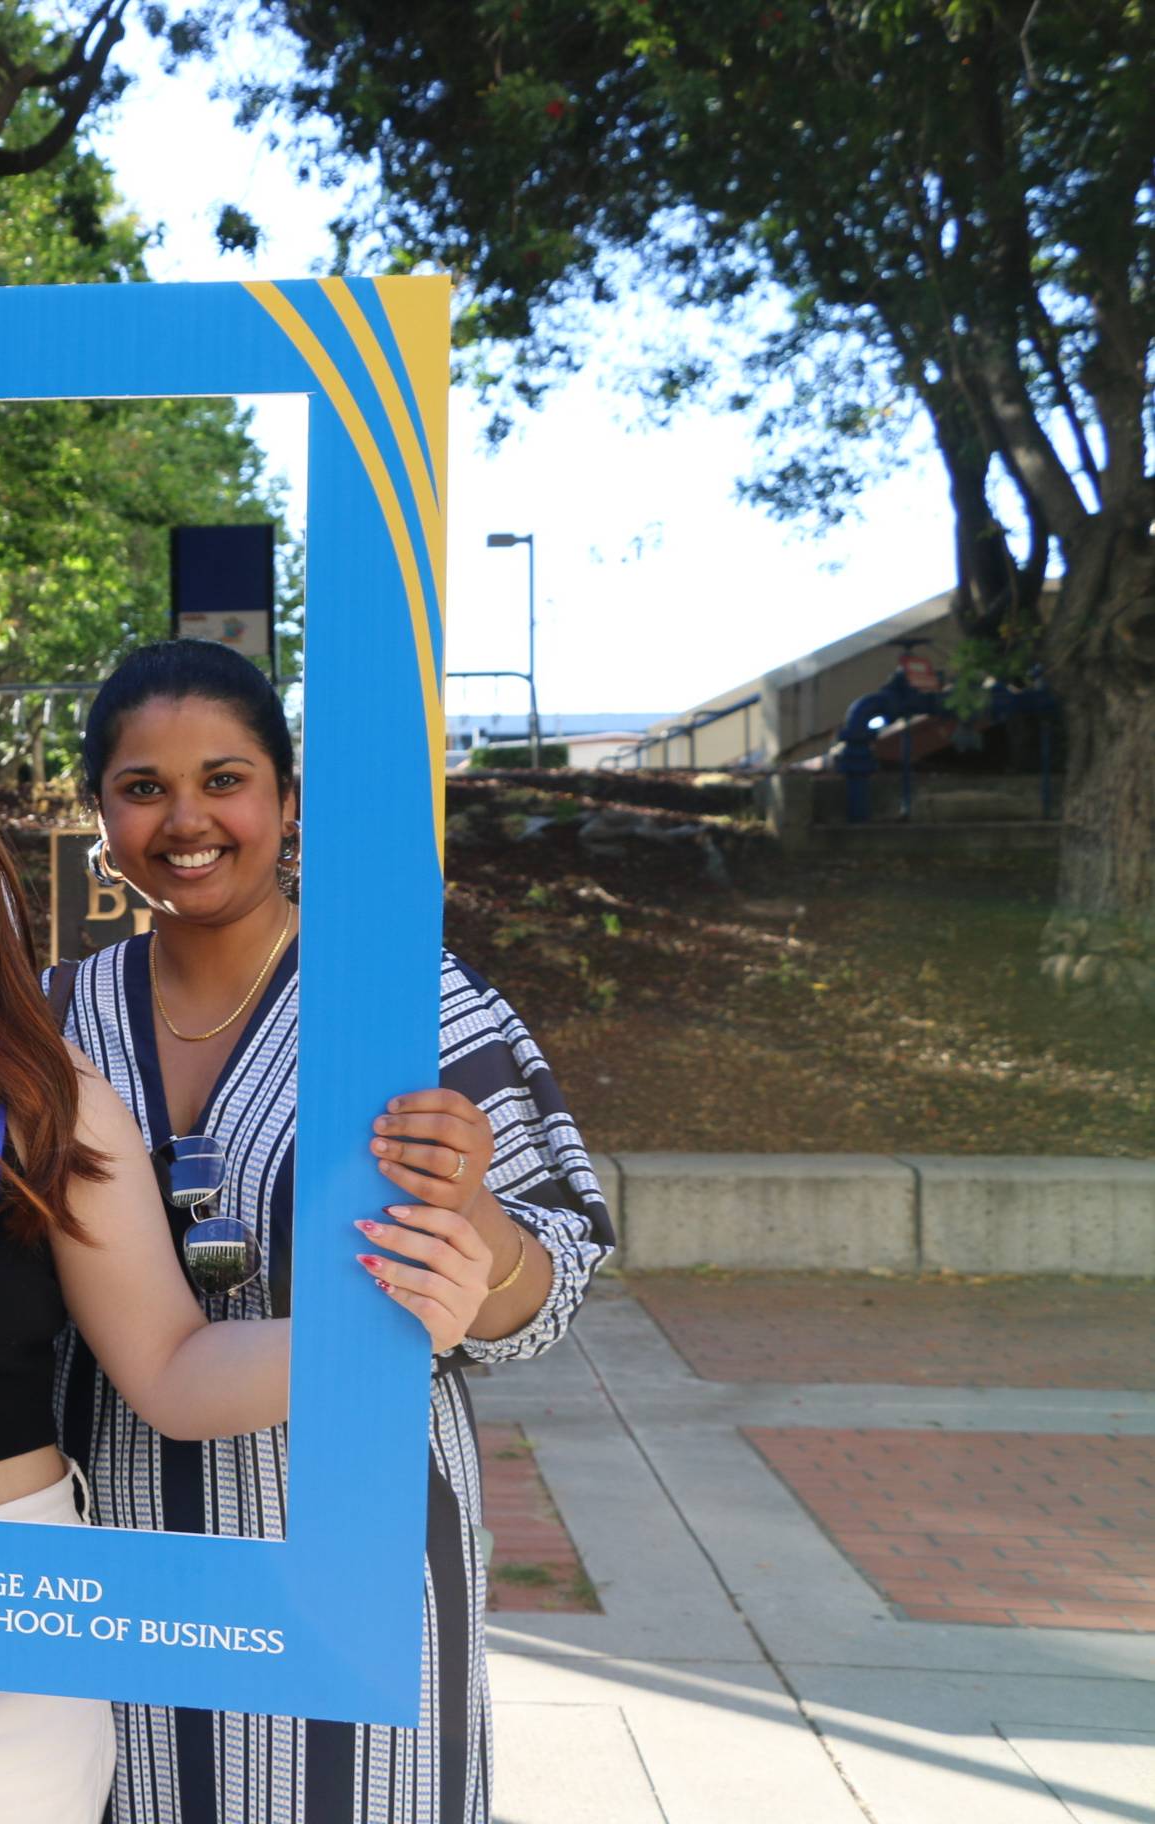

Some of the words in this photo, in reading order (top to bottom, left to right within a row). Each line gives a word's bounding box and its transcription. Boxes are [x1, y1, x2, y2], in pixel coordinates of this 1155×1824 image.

[32, 1575, 103, 1603] AND
[90, 1615, 131, 1641] OF
[140, 1619, 285, 1654] BUSINESS
